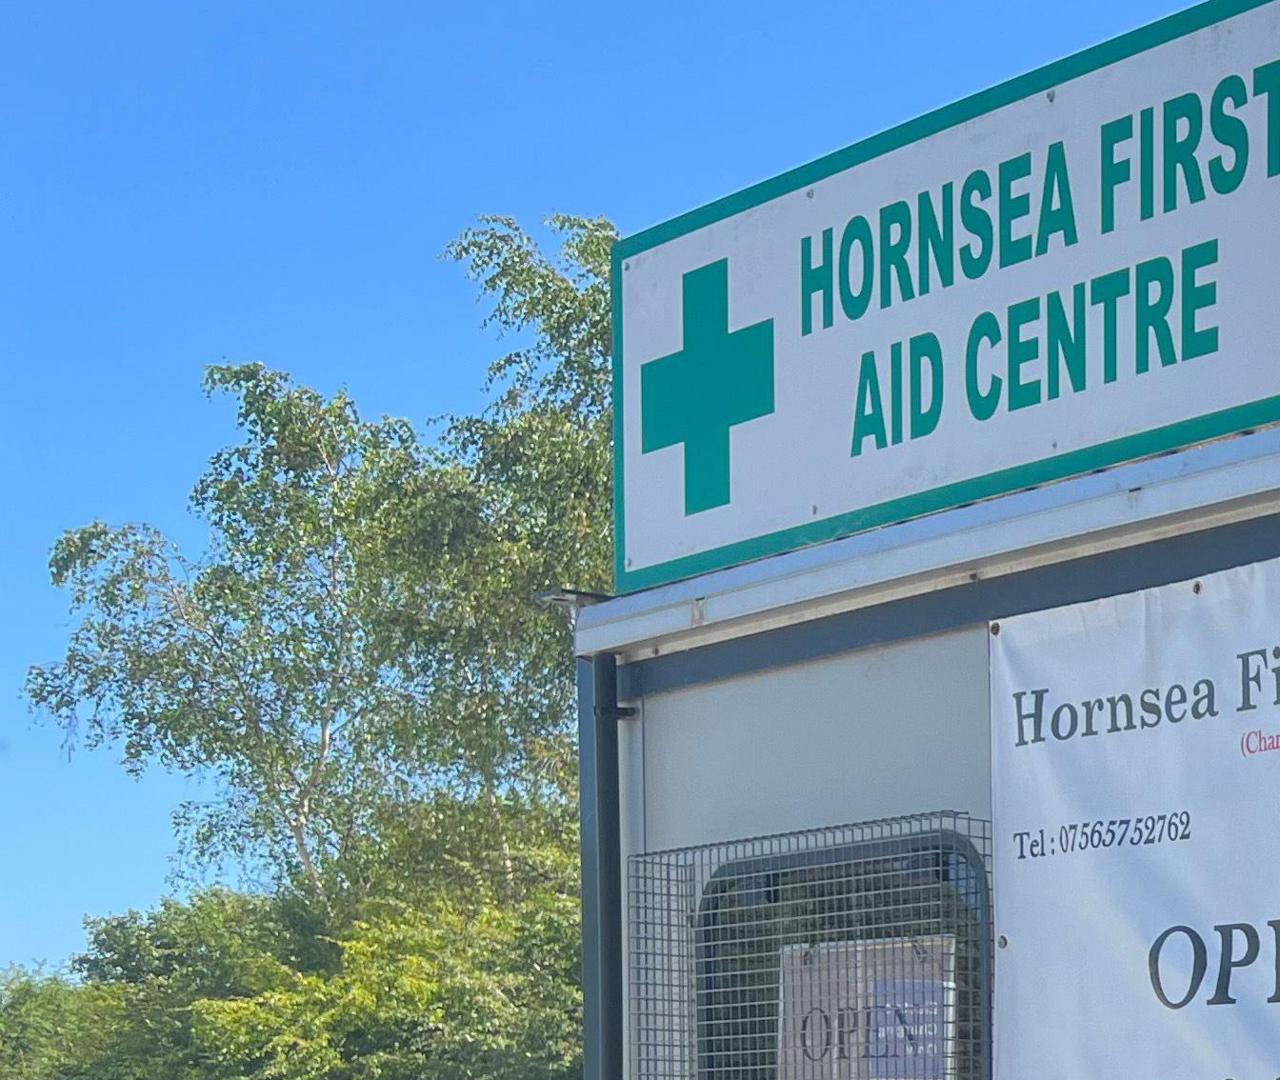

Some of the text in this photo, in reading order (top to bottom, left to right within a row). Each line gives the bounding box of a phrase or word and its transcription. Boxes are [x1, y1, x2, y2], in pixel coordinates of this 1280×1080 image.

[799, 140, 1079, 338] HORNSEA
[850, 238, 1219, 458] AID CENTRE
[1012, 670, 1219, 748] Hornsea
[1059, 811, 1192, 854] 07565752762
[801, 1005, 918, 1062] OPEN
